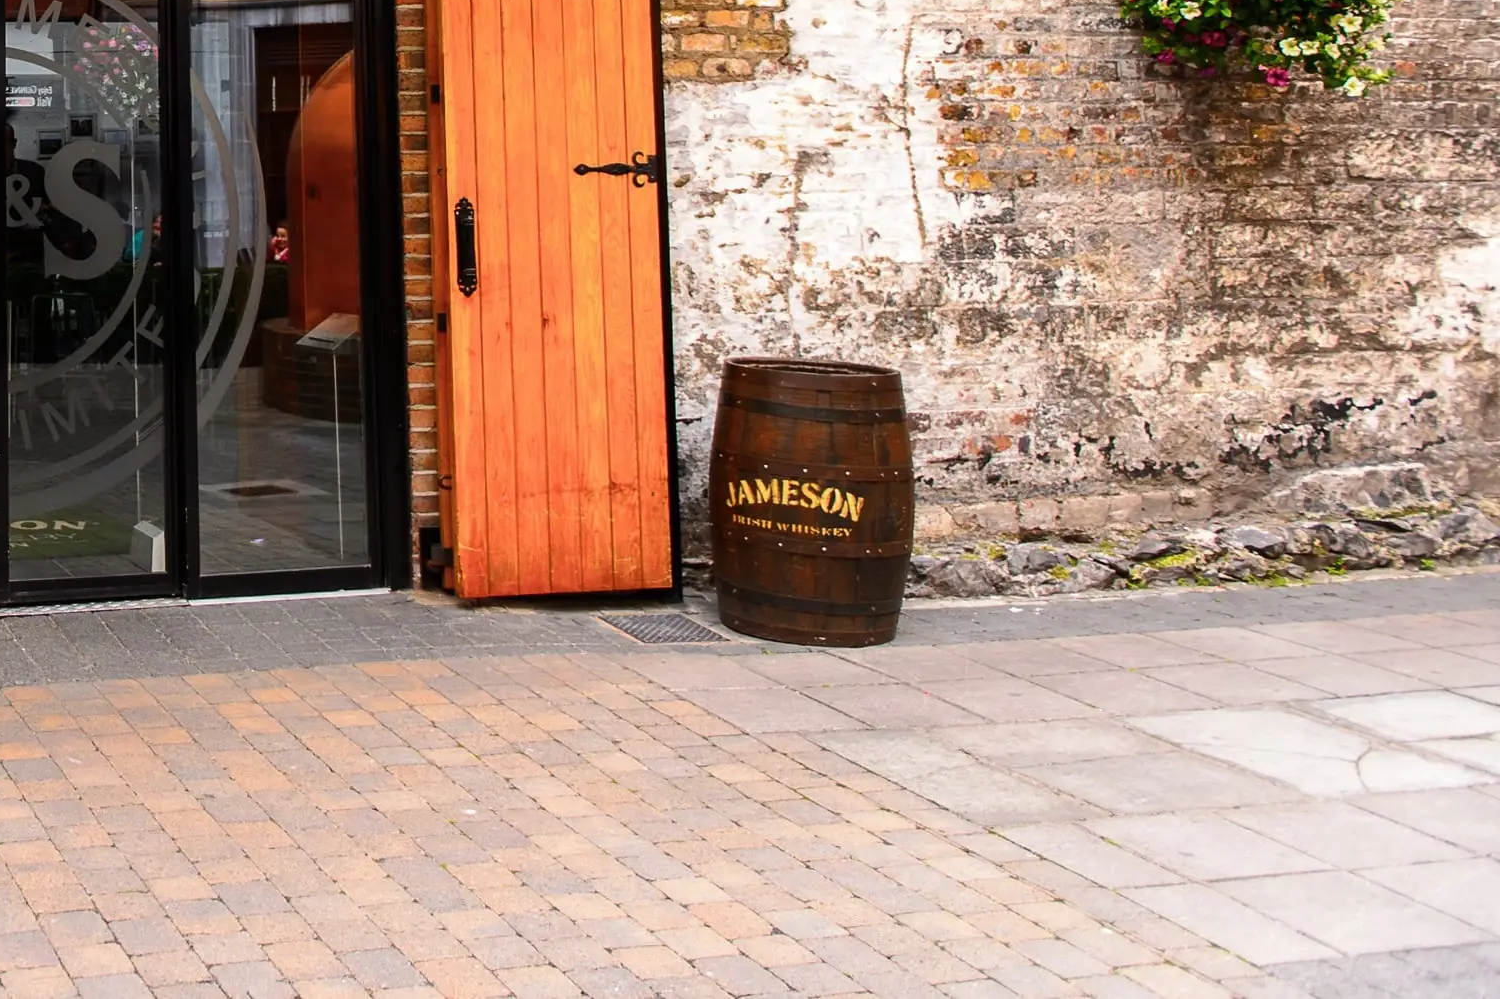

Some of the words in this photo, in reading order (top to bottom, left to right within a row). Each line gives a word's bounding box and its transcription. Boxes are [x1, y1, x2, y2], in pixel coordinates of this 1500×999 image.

[726, 478, 864, 522] JAMESON
[732, 514, 772, 530] IRISH
[776, 522, 853, 537] WHISKEY
